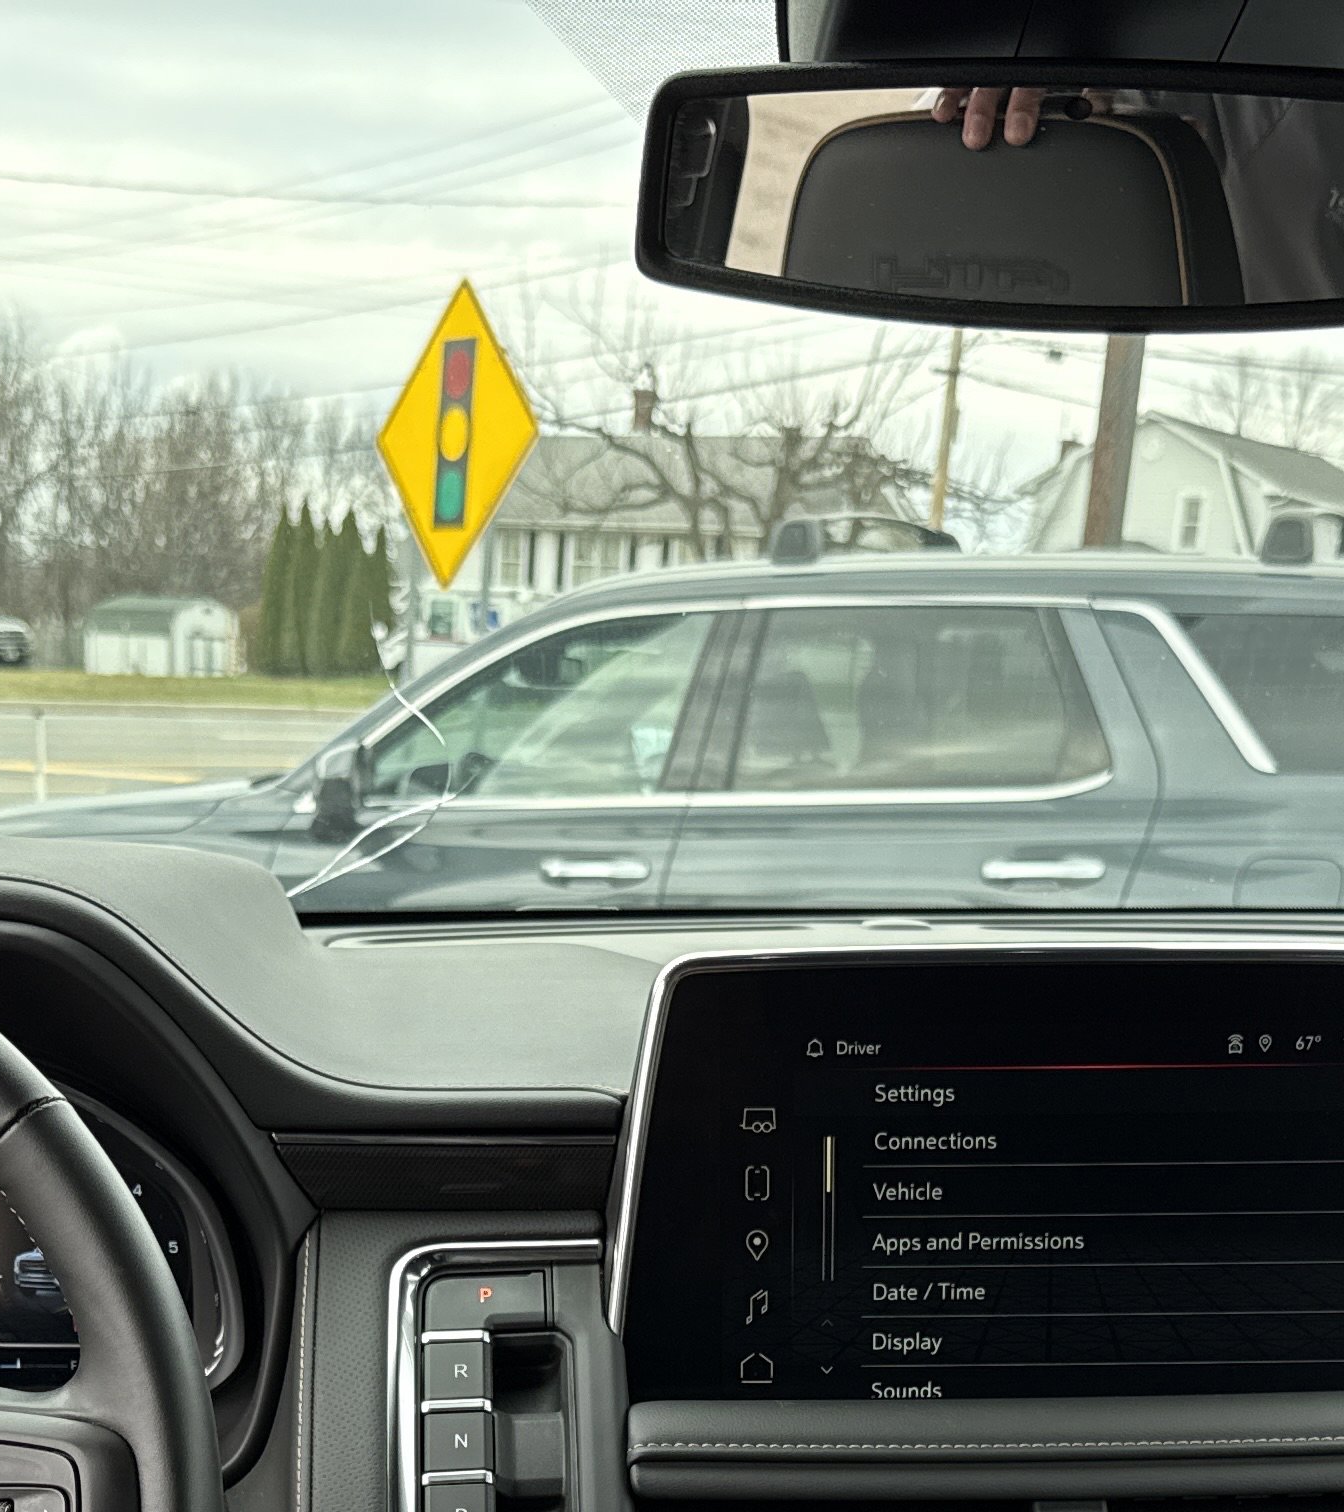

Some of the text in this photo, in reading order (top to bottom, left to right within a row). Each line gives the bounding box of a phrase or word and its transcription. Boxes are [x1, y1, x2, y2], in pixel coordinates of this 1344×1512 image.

[836, 1041, 881, 1055] Driver
[874, 1084, 956, 1107] Settings
[873, 1131, 997, 1150] Connections
[132, 1184, 143, 1197] 4
[873, 1182, 943, 1201] Vehicle
[168, 1241, 179, 1254] 5
[872, 1232, 1085, 1256] Apps and Permissions
[478, 1287, 492, 1303] P
[872, 1283, 918, 1301] Date
[937, 1282, 986, 1300] Time
[872, 1332, 943, 1355] Display
[453, 1363, 469, 1379] R
[871, 1381, 943, 1399] Sounds
[454, 1433, 469, 1449] N
